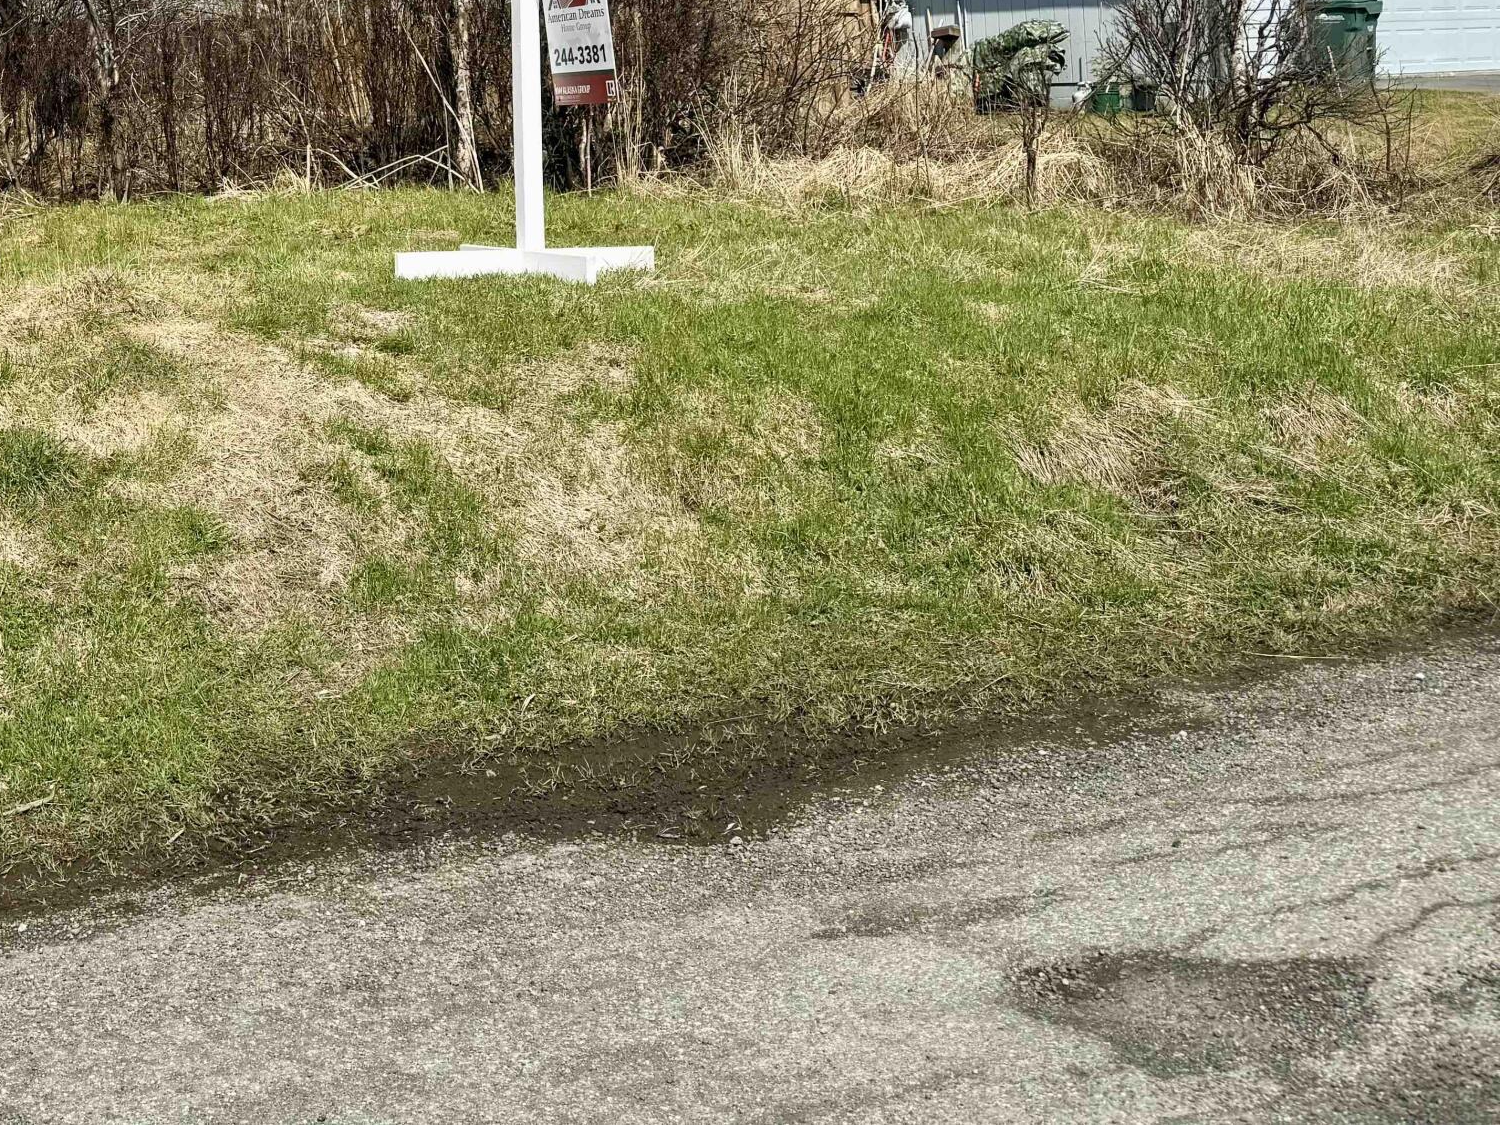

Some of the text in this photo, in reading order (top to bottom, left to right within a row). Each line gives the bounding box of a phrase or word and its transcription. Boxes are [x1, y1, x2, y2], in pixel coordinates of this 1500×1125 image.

[548, 8, 605, 24] American Dreams
[554, 44, 607, 66] 244-3381
